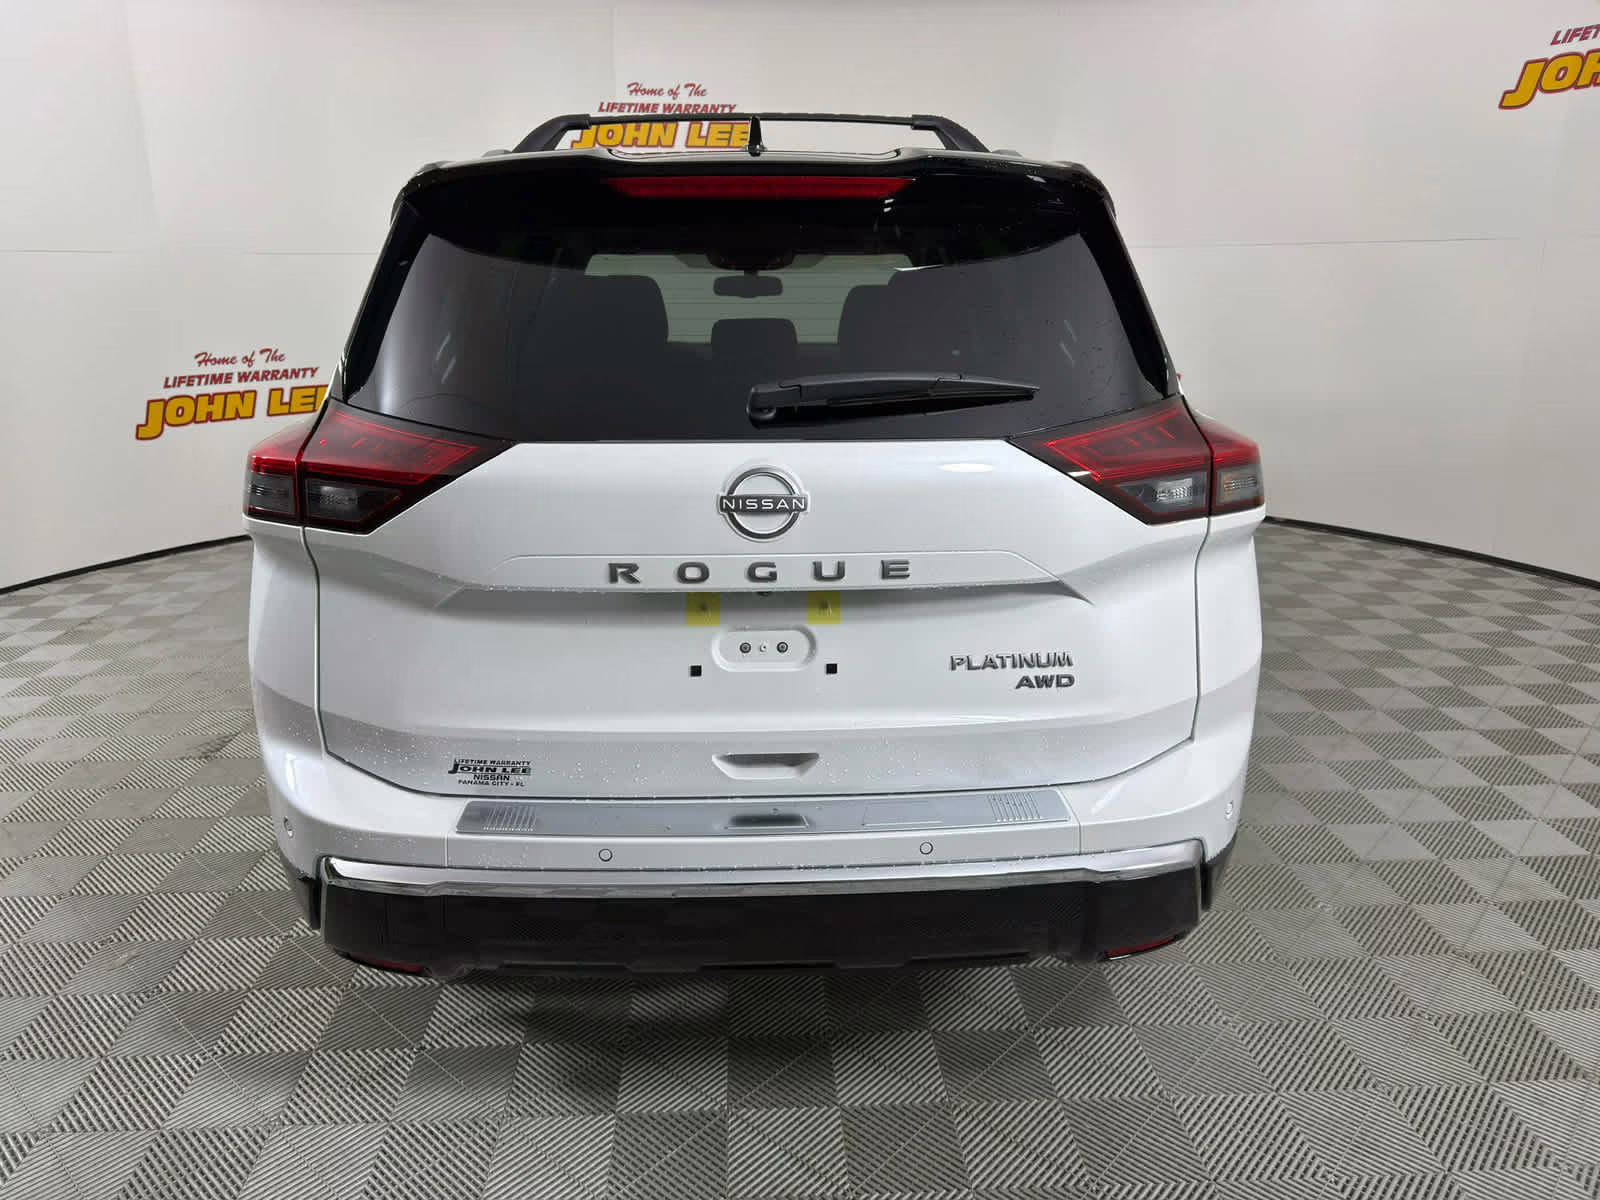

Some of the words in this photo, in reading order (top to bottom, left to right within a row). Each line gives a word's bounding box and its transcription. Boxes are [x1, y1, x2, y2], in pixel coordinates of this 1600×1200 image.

[627, 82, 664, 97] Home
[667, 84, 681, 99] of
[684, 82, 708, 97] The
[598, 102, 659, 113] LIFETIME
[662, 103, 737, 114] WARRANTY
[571, 122, 678, 150] JOHN
[685, 121, 750, 149] LEE
[194, 352, 237, 367] Home
[241, 350, 256, 367] of
[259, 348, 285, 363] The
[163, 372, 233, 389] LIFETIME
[237, 367, 320, 383] WARRANTY
[136, 390, 257, 440] JOHN
[722, 498, 806, 510] NISSAN
[608, 560, 911, 584] ROGUE
[950, 651, 1073, 671] PLATINUM
[1015, 674, 1075, 689] AWD
[448, 763, 497, 774] JOHN
[501, 766, 531, 775] LEE
